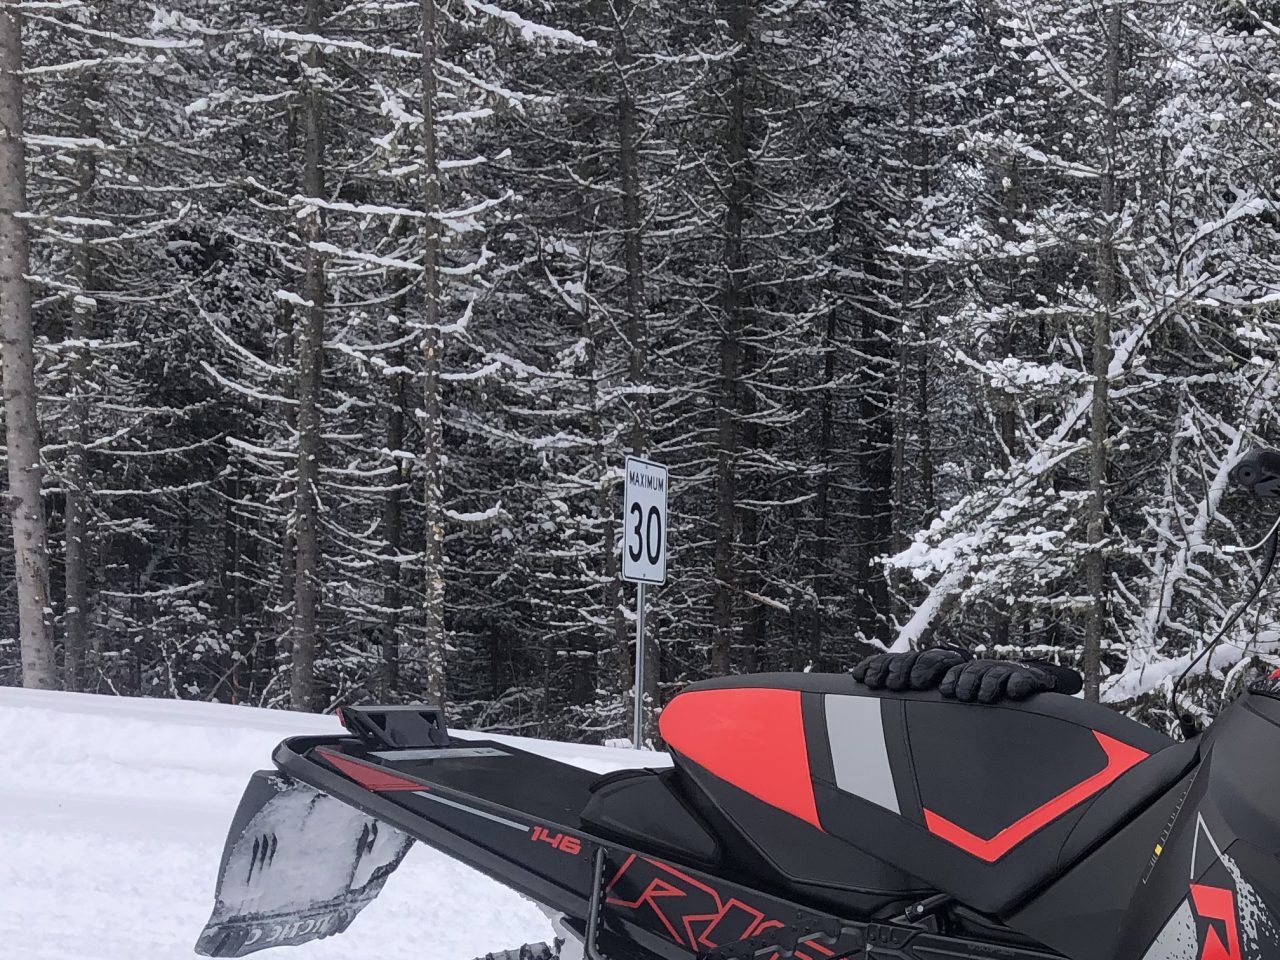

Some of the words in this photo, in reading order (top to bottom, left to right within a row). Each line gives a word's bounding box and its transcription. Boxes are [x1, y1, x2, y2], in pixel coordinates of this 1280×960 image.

[629, 470, 664, 493] MAXIMUM
[628, 501, 662, 565] 30
[531, 825, 582, 855] 146
